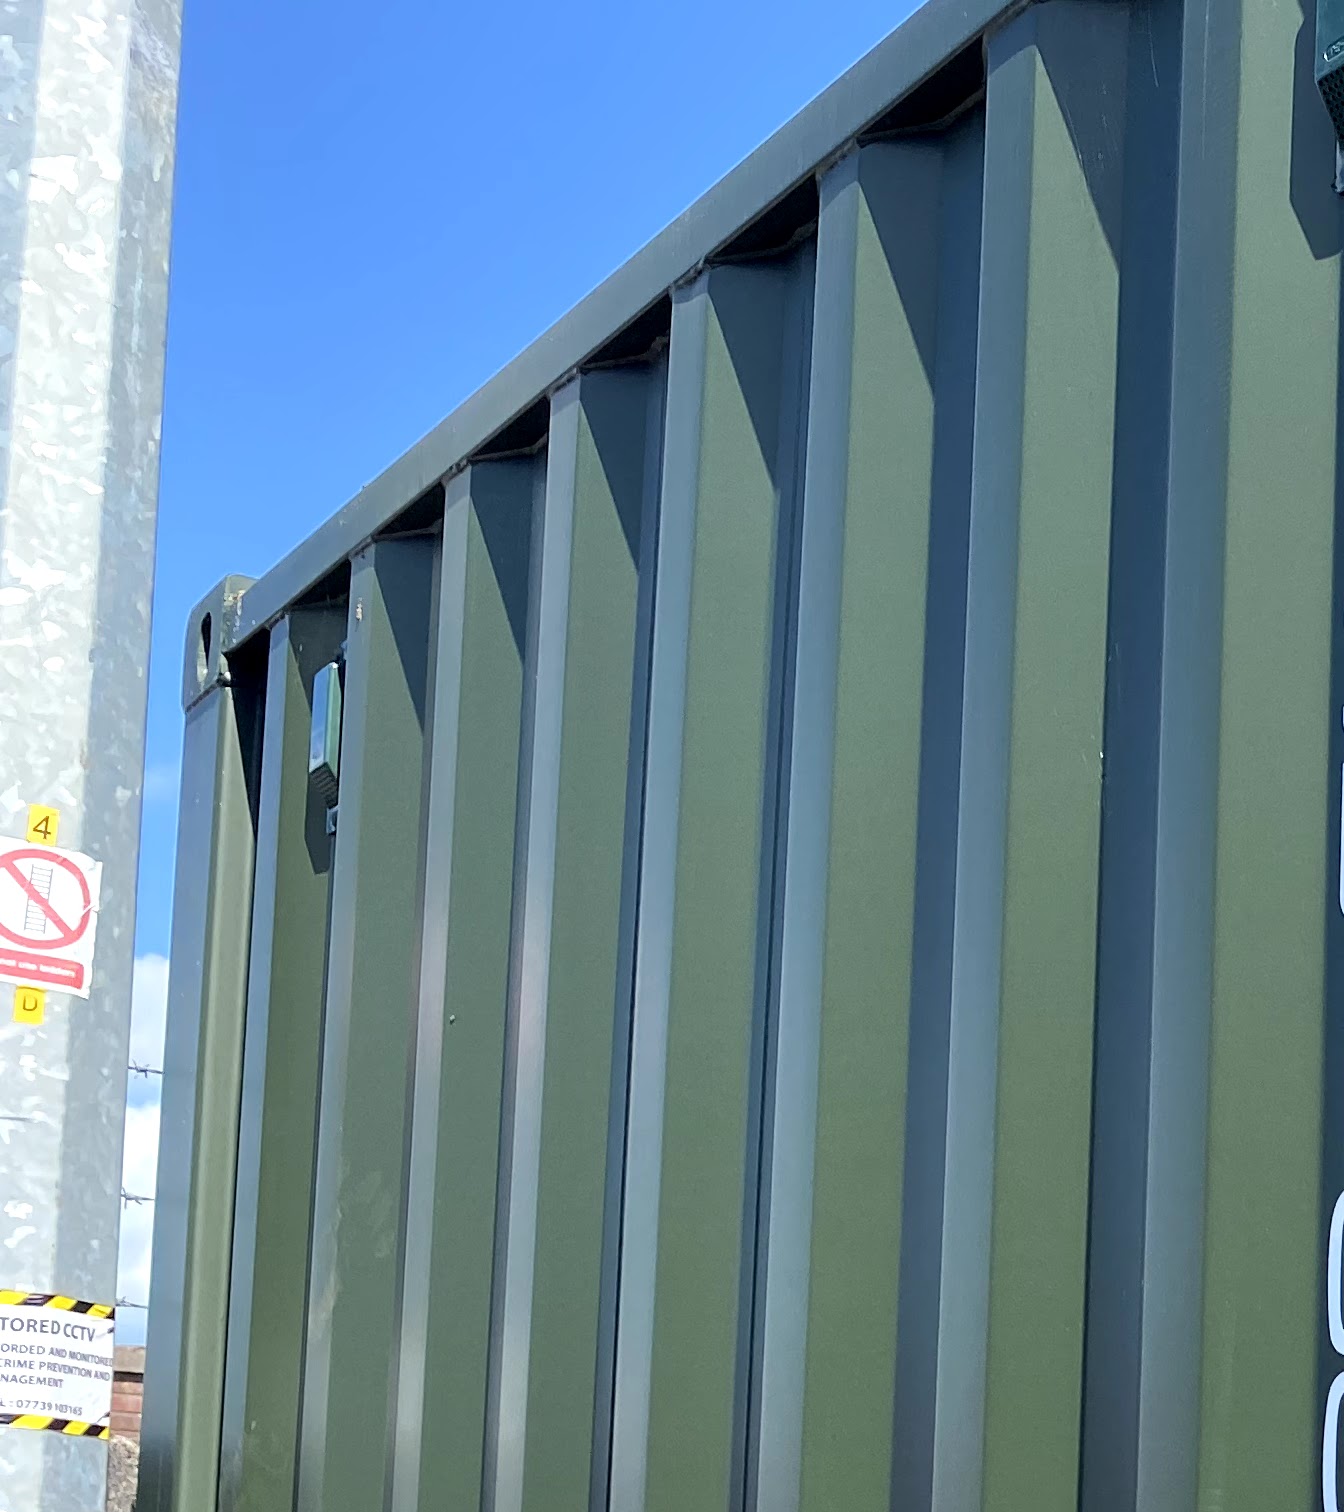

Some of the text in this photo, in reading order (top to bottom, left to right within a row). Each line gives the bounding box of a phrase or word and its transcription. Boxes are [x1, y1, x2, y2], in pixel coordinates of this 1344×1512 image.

[33, 815, 51, 840] 4
[0, 1316, 96, 1342] TORED CCTV
[0, 1343, 46, 1355] ORDED
[48, 1346, 67, 1359] AND
[0, 1373, 64, 1389] NAGEMENT
[39, 1361, 92, 1379] PREVENTION
[94, 1370, 110, 1382] AND
